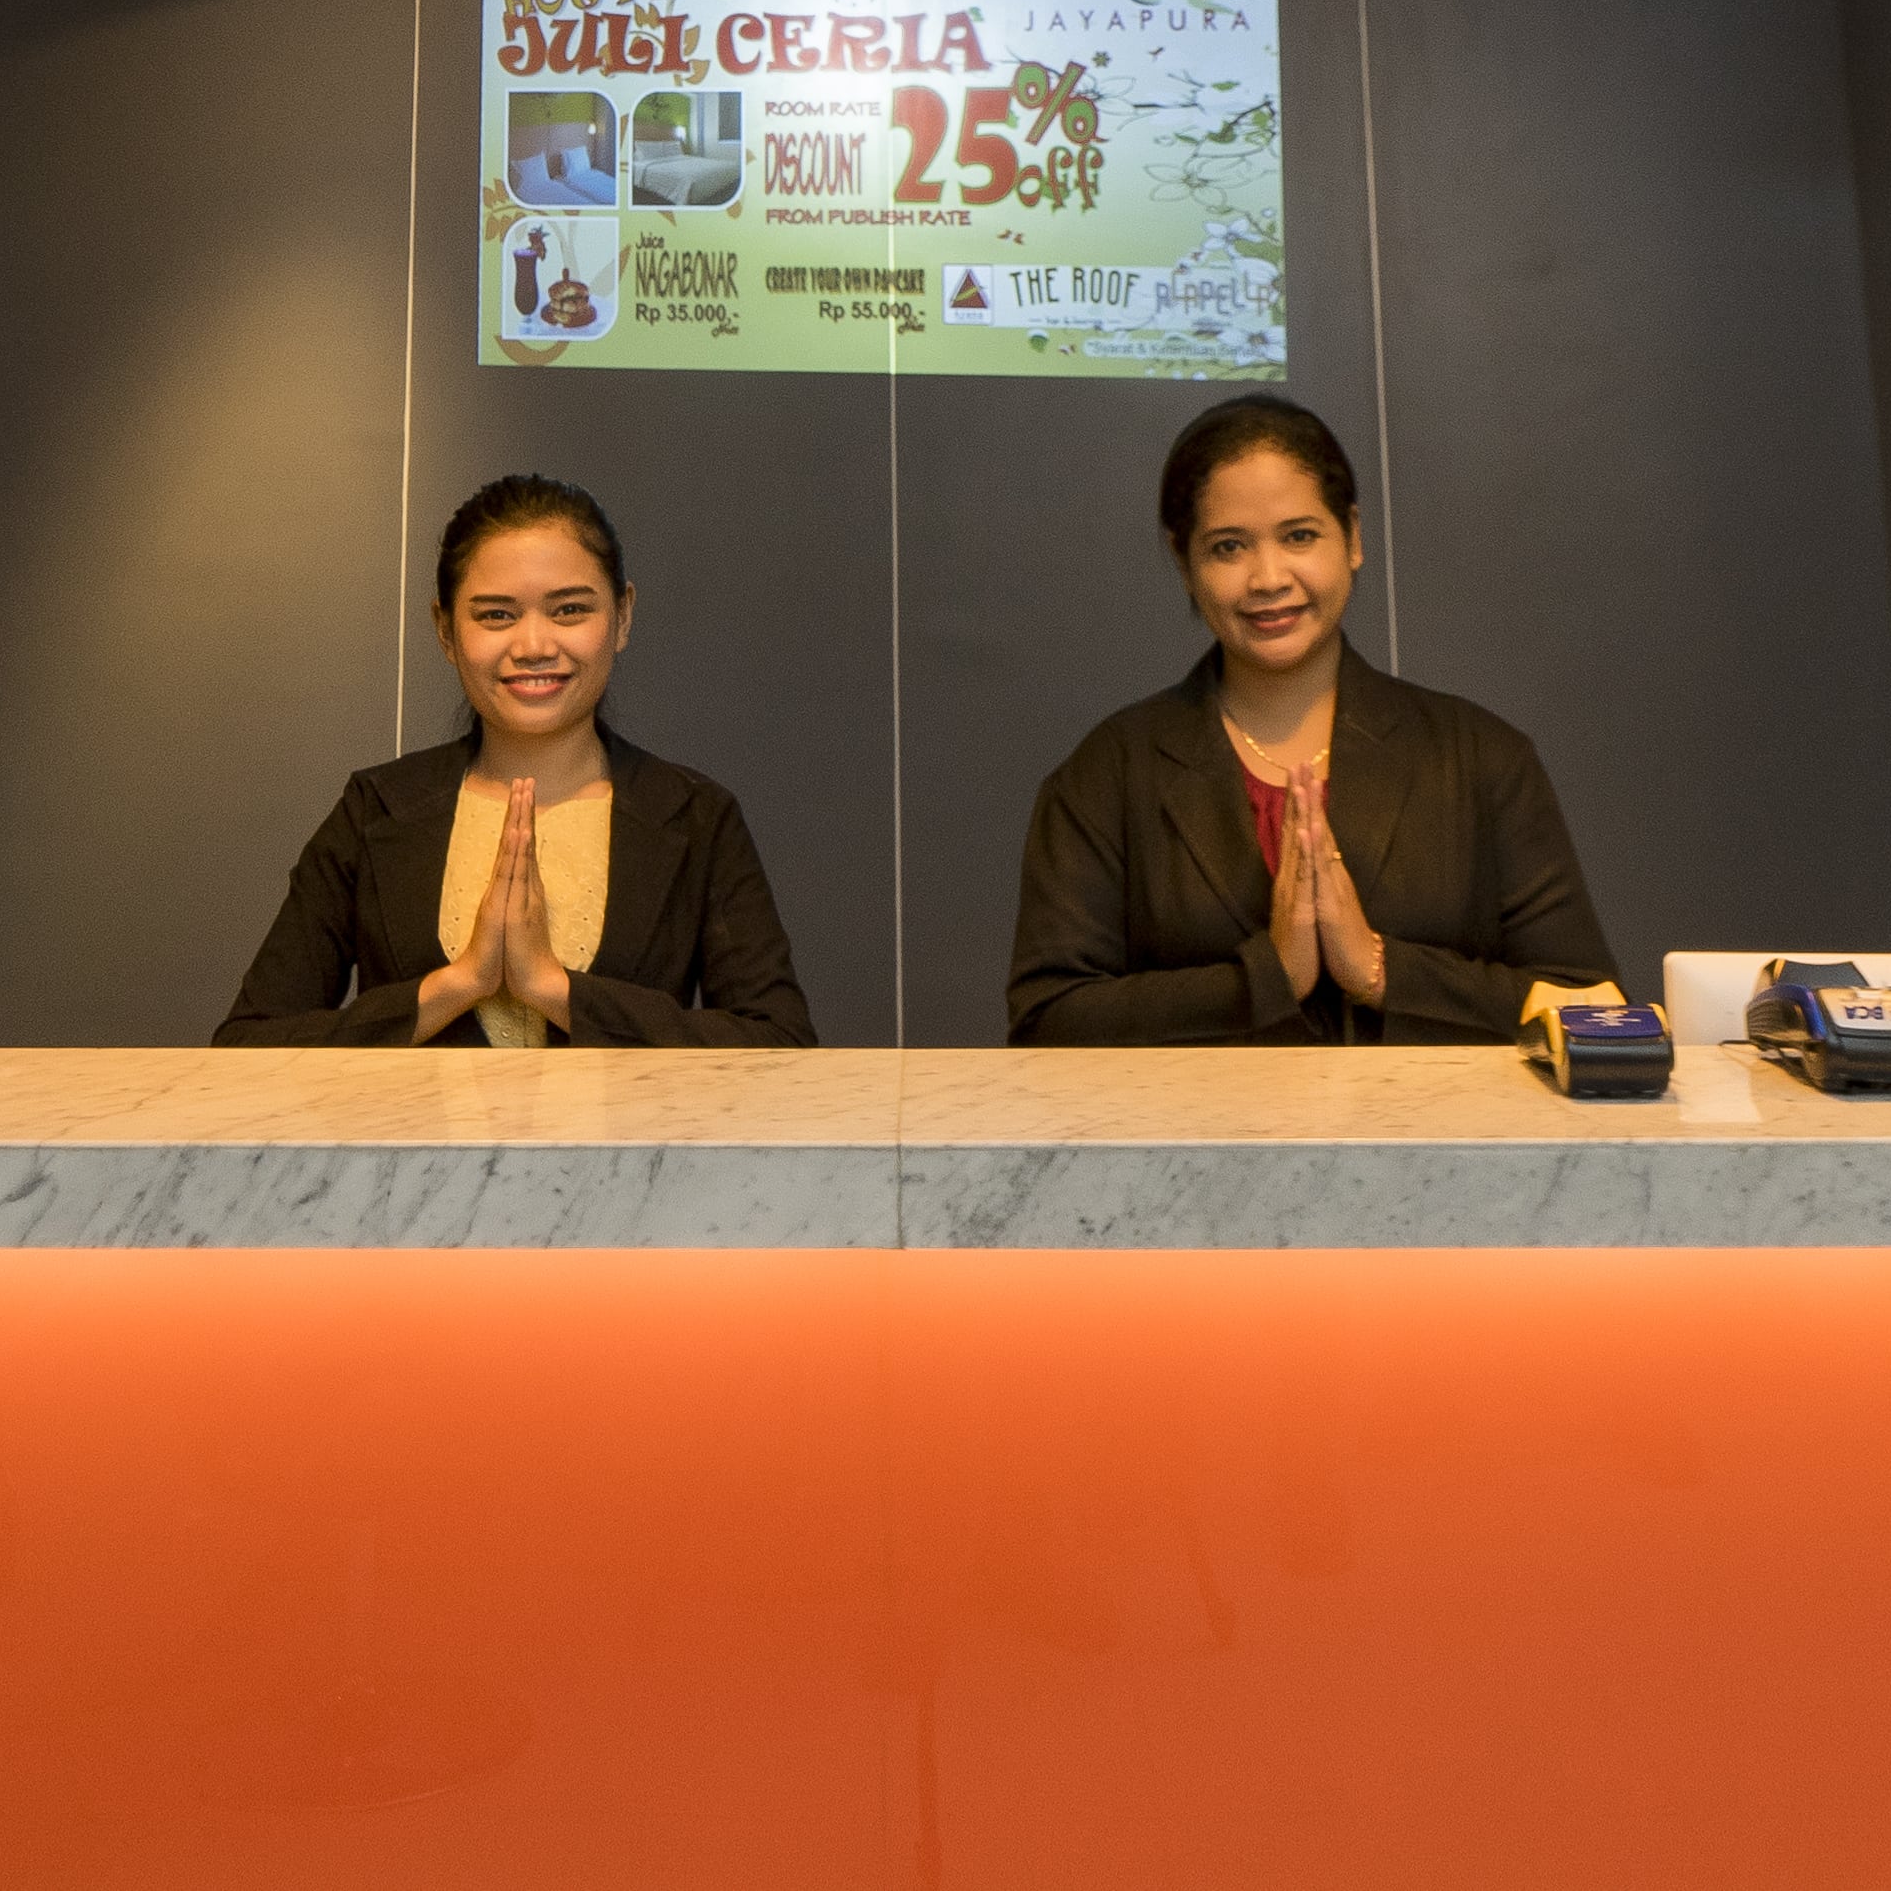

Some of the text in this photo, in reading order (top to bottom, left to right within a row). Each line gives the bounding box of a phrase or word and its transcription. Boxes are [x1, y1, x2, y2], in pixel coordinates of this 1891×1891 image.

[1023, 8, 1252, 33] JAYAPURA
[497, 11, 993, 76] JULI CERIA
[764, 101, 882, 117] ROOM RATE
[764, 130, 867, 197] DISCOUNT
[1017, 146, 1104, 214] off
[765, 209, 972, 227] FROM PUBLISH RATE
[635, 232, 665, 250] Juice
[635, 249, 740, 299] NAGABONAR
[1009, 266, 1141, 309] THE ROOF
[635, 303, 660, 326] Rp
[819, 300, 846, 322] Rp
[1845, 1005, 1884, 1020] BCA
